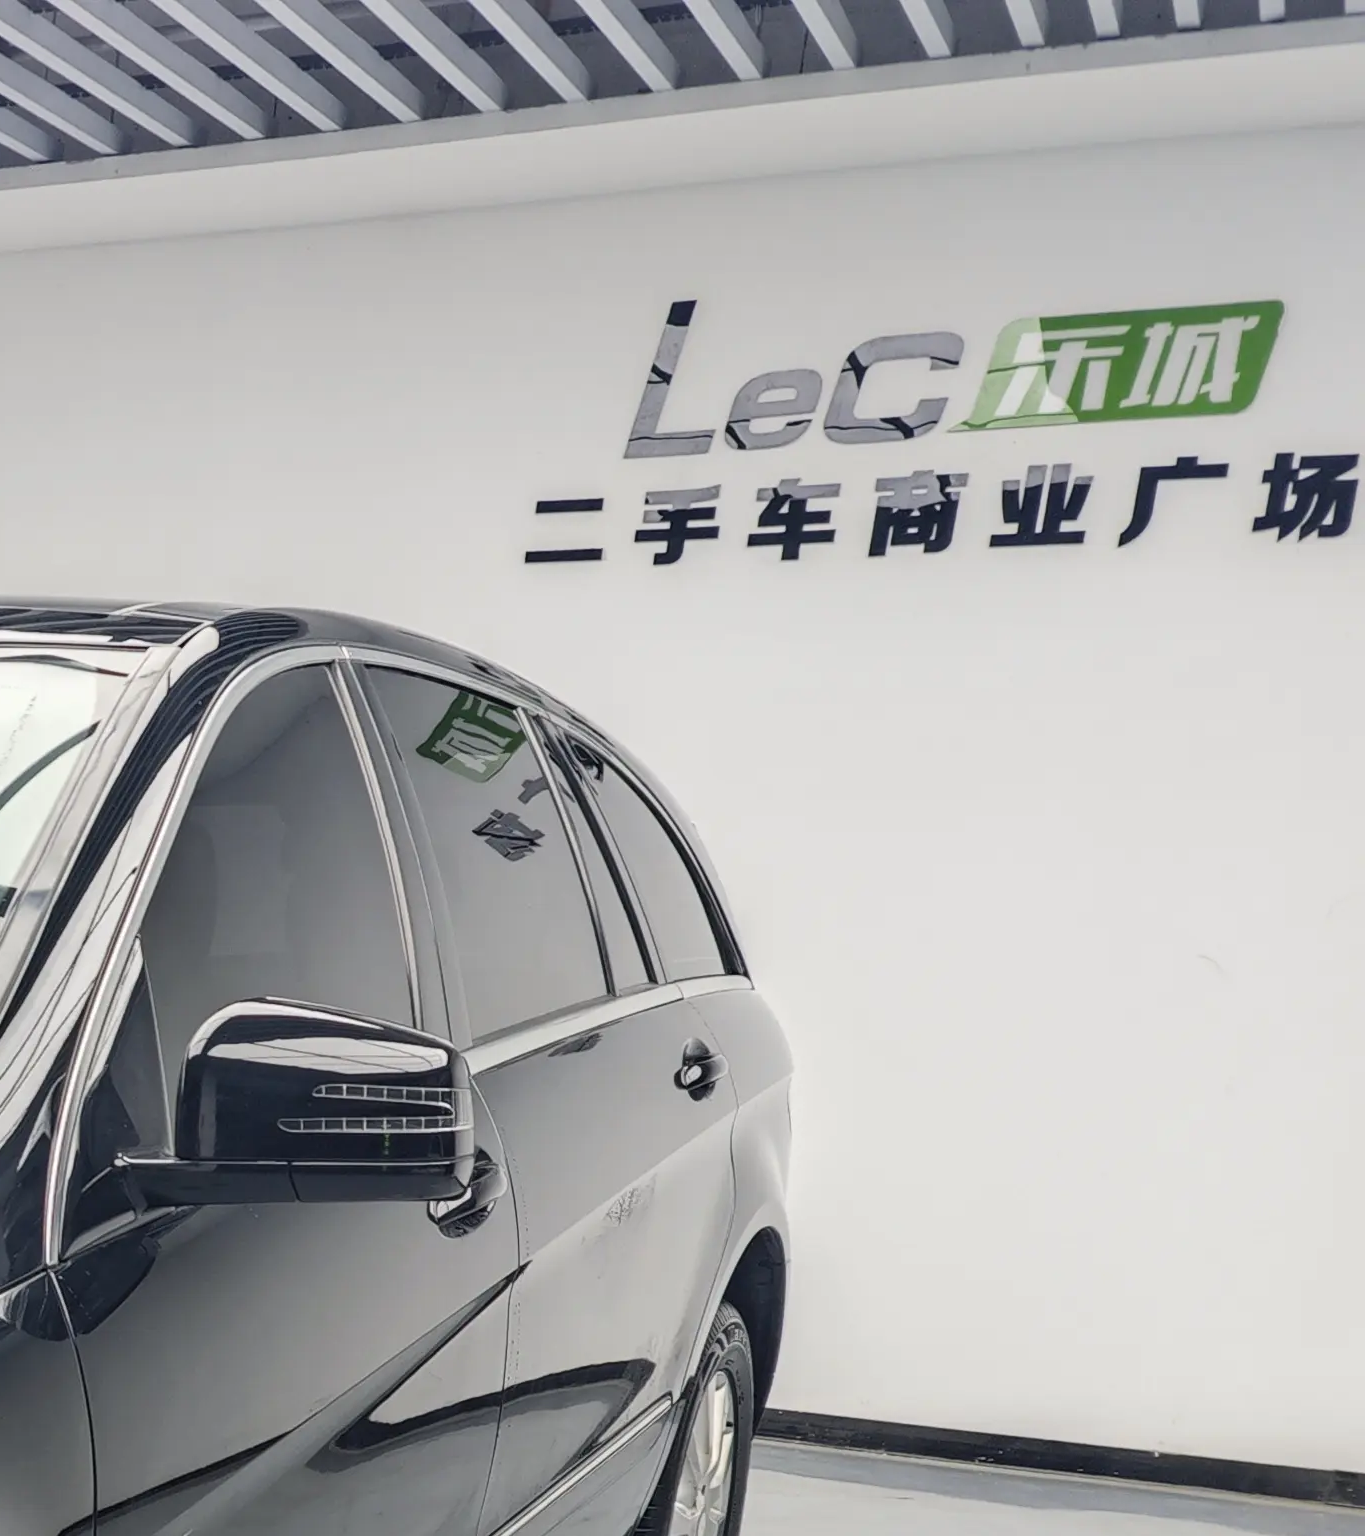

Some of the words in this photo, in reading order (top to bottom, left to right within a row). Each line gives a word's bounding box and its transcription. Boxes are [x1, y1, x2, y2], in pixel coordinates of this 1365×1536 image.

[624, 299, 964, 459] LeC
[525, 452, 1362, 566] 二手车商业广场
